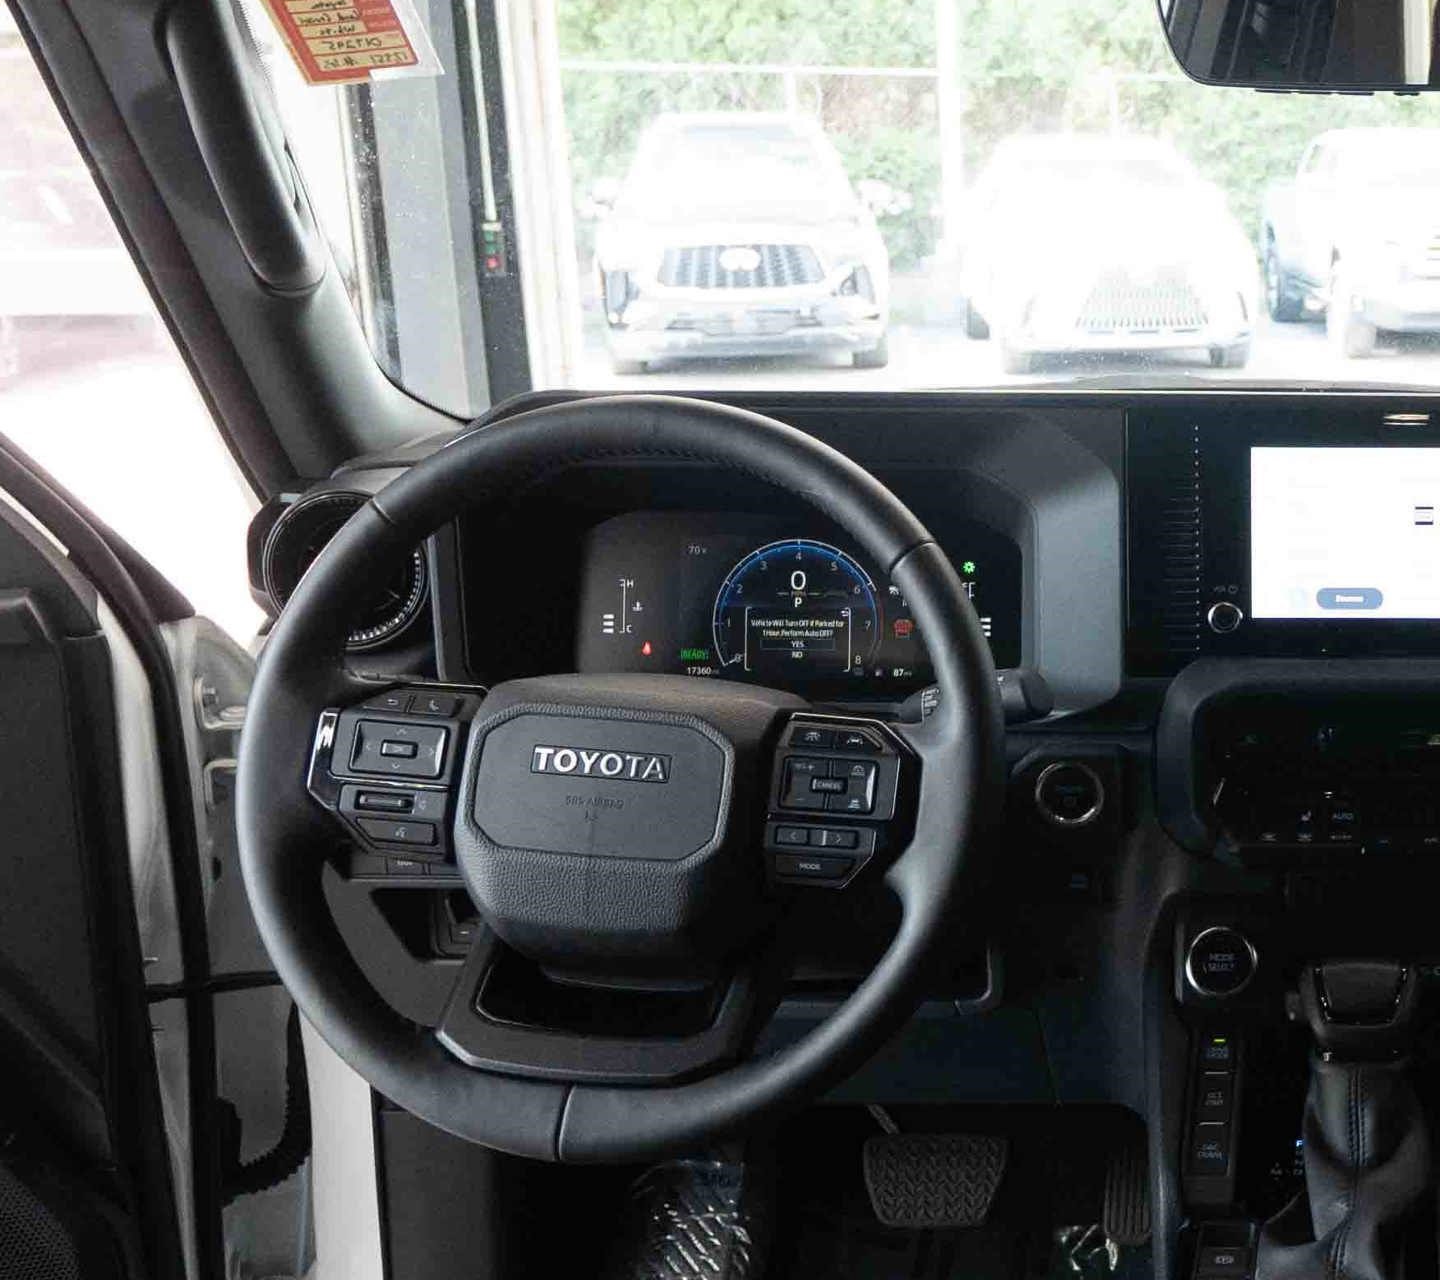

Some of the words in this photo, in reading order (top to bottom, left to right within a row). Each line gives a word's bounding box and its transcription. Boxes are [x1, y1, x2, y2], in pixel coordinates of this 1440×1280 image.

[795, 552, 802, 560] 4
[761, 562, 768, 570] 3
[831, 562, 838, 571] 5
[627, 580, 634, 588] H
[790, 570, 807, 590] 0
[737, 584, 744, 594] 2
[795, 598, 803, 608] P
[626, 624, 633, 633] C
[865, 621, 872, 630] 7
[855, 655, 862, 664] 8
[687, 666, 712, 675] 17360
[534, 746, 663, 780] TOYOTA
[799, 862, 822, 871] MODE
